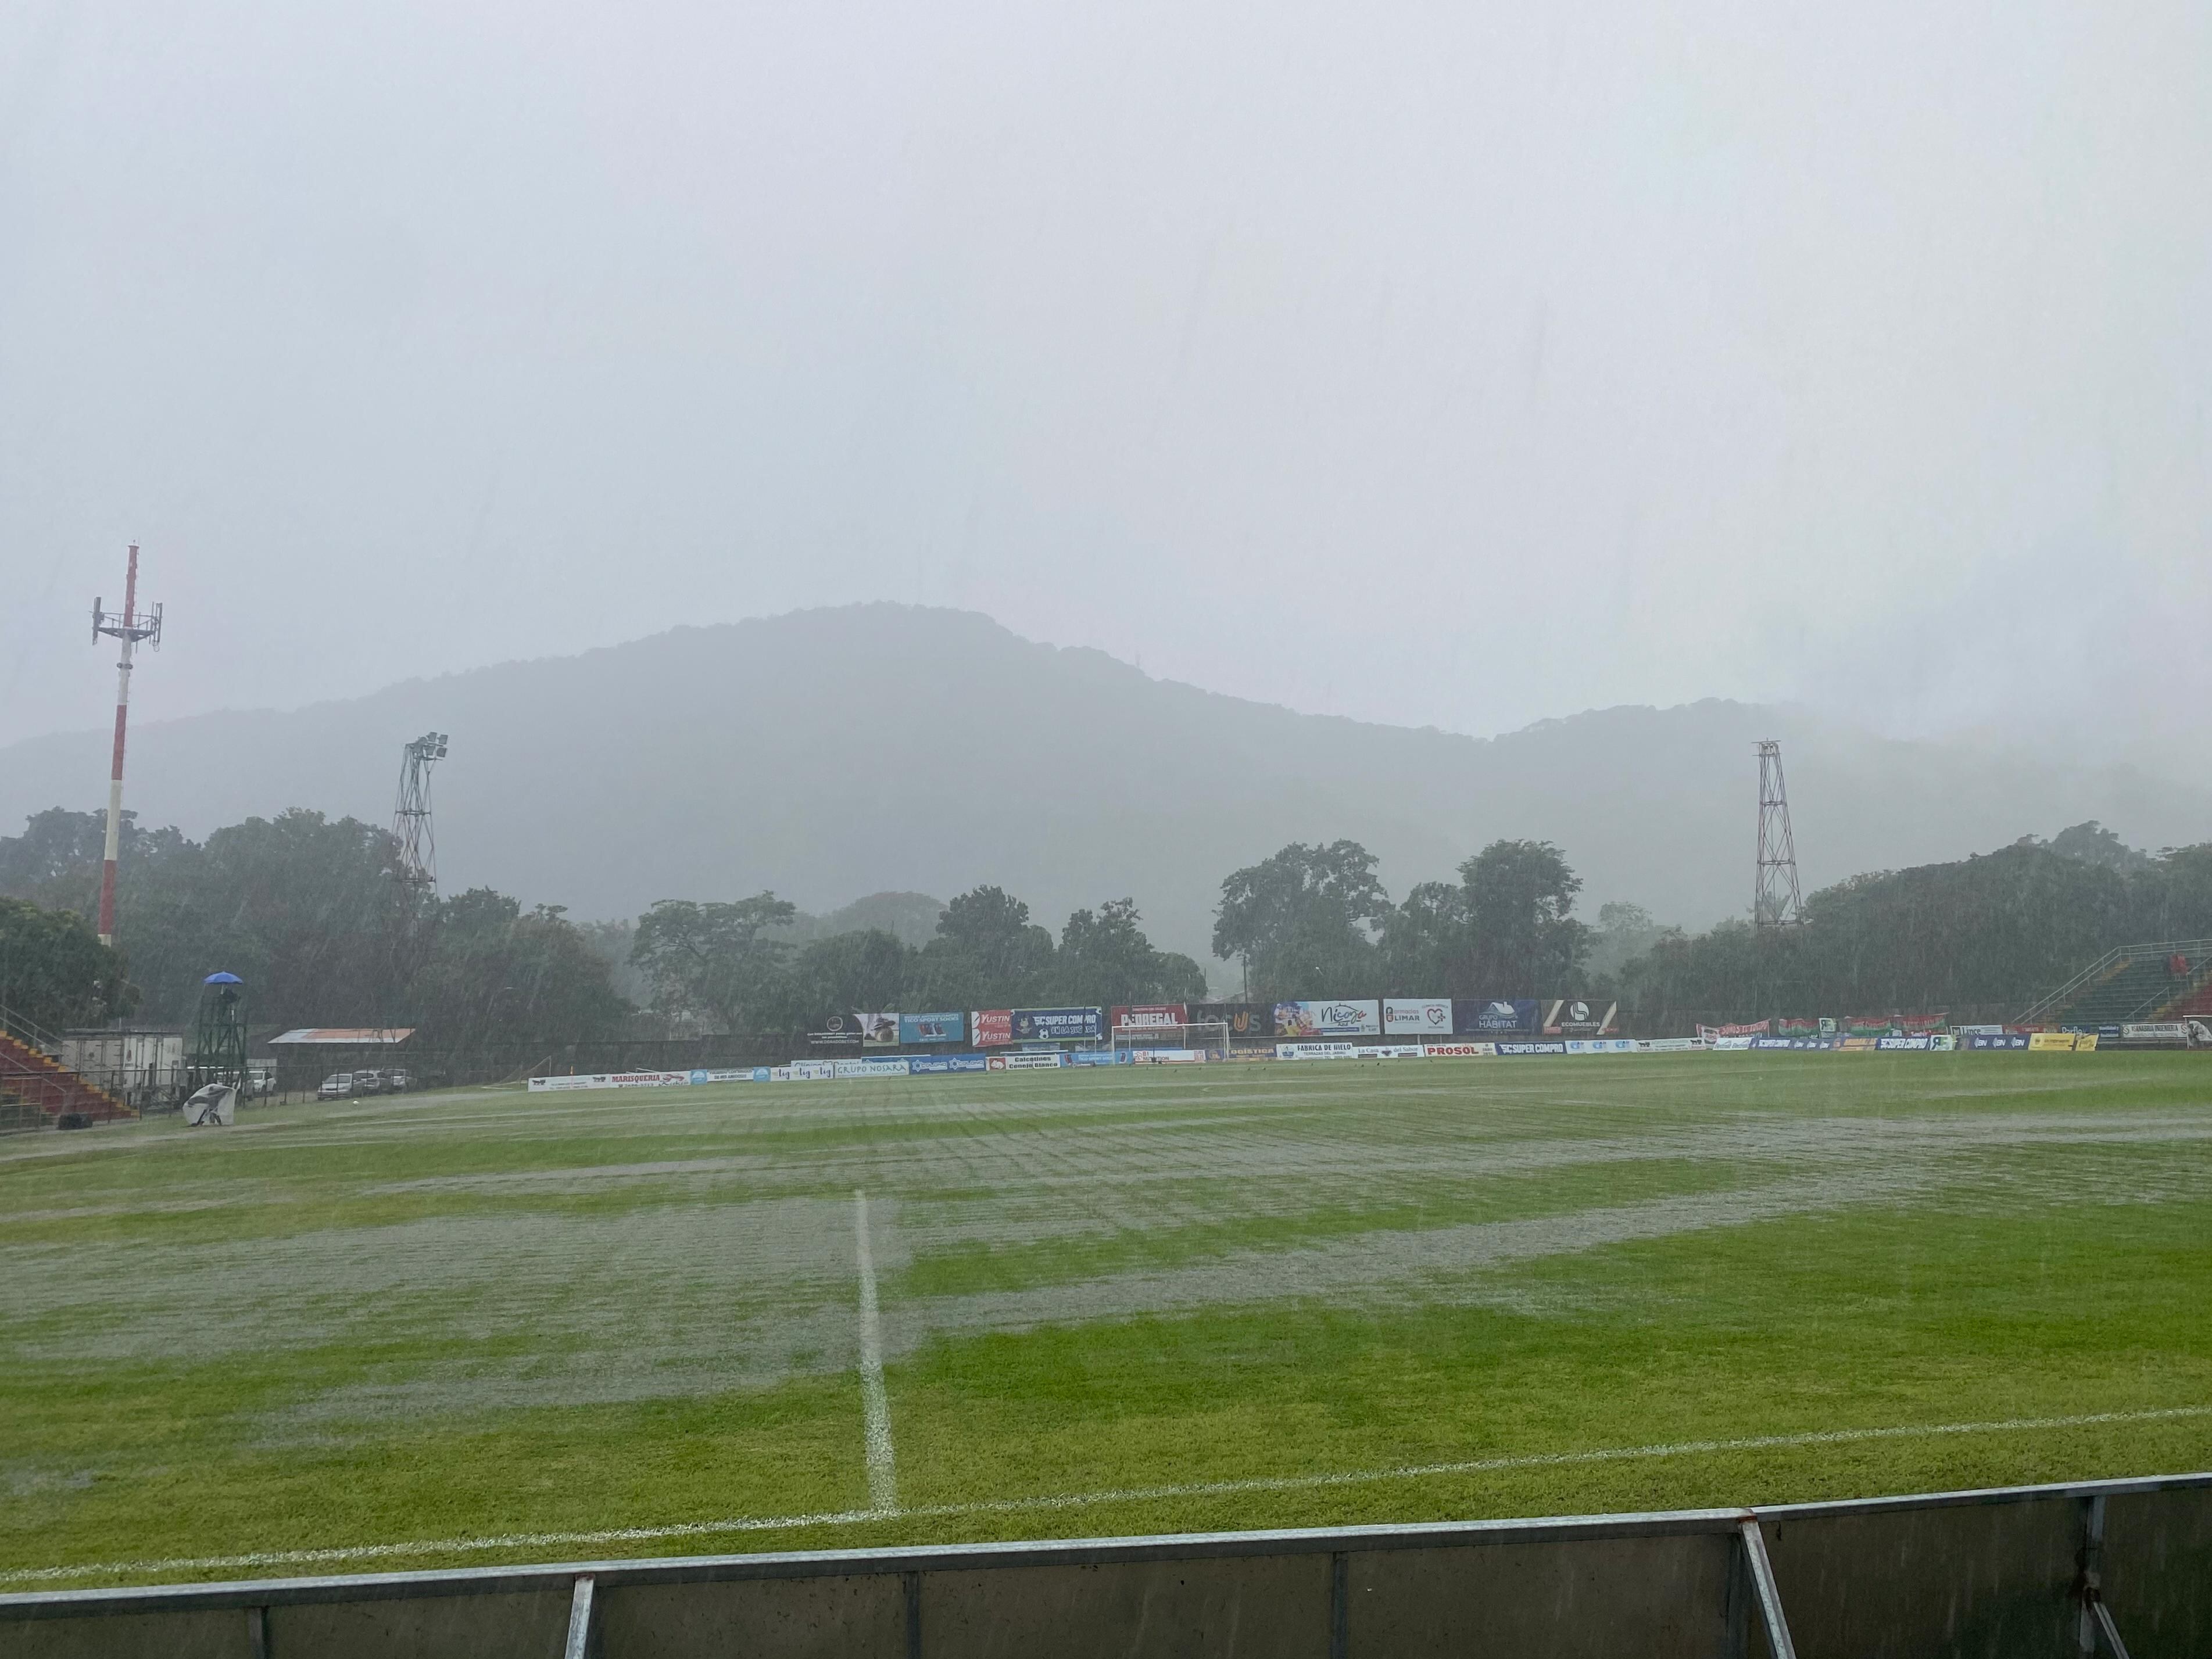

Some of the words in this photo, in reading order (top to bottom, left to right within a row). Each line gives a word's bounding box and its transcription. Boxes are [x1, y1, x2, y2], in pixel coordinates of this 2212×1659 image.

[980, 1014, 1010, 1024] YUSTIN
[1121, 1012, 1178, 1027] PEDREGAL
[1322, 1006, 1367, 1024] Nicoya
[1045, 1016, 1067, 1026] SUPER
[1061, 1026, 1070, 1034] LA
[981, 1031, 1011, 1041] YUSTIN
[1427, 1047, 1479, 1055] PROSOL
[1512, 1044, 1534, 1053] SUPER
[1535, 1044, 1563, 1053] COMPRO
[837, 1065, 867, 1074] GRUPO
[869, 1063, 907, 1073] NOSARA
[611, 1074, 660, 1083] MARISQUERIA
